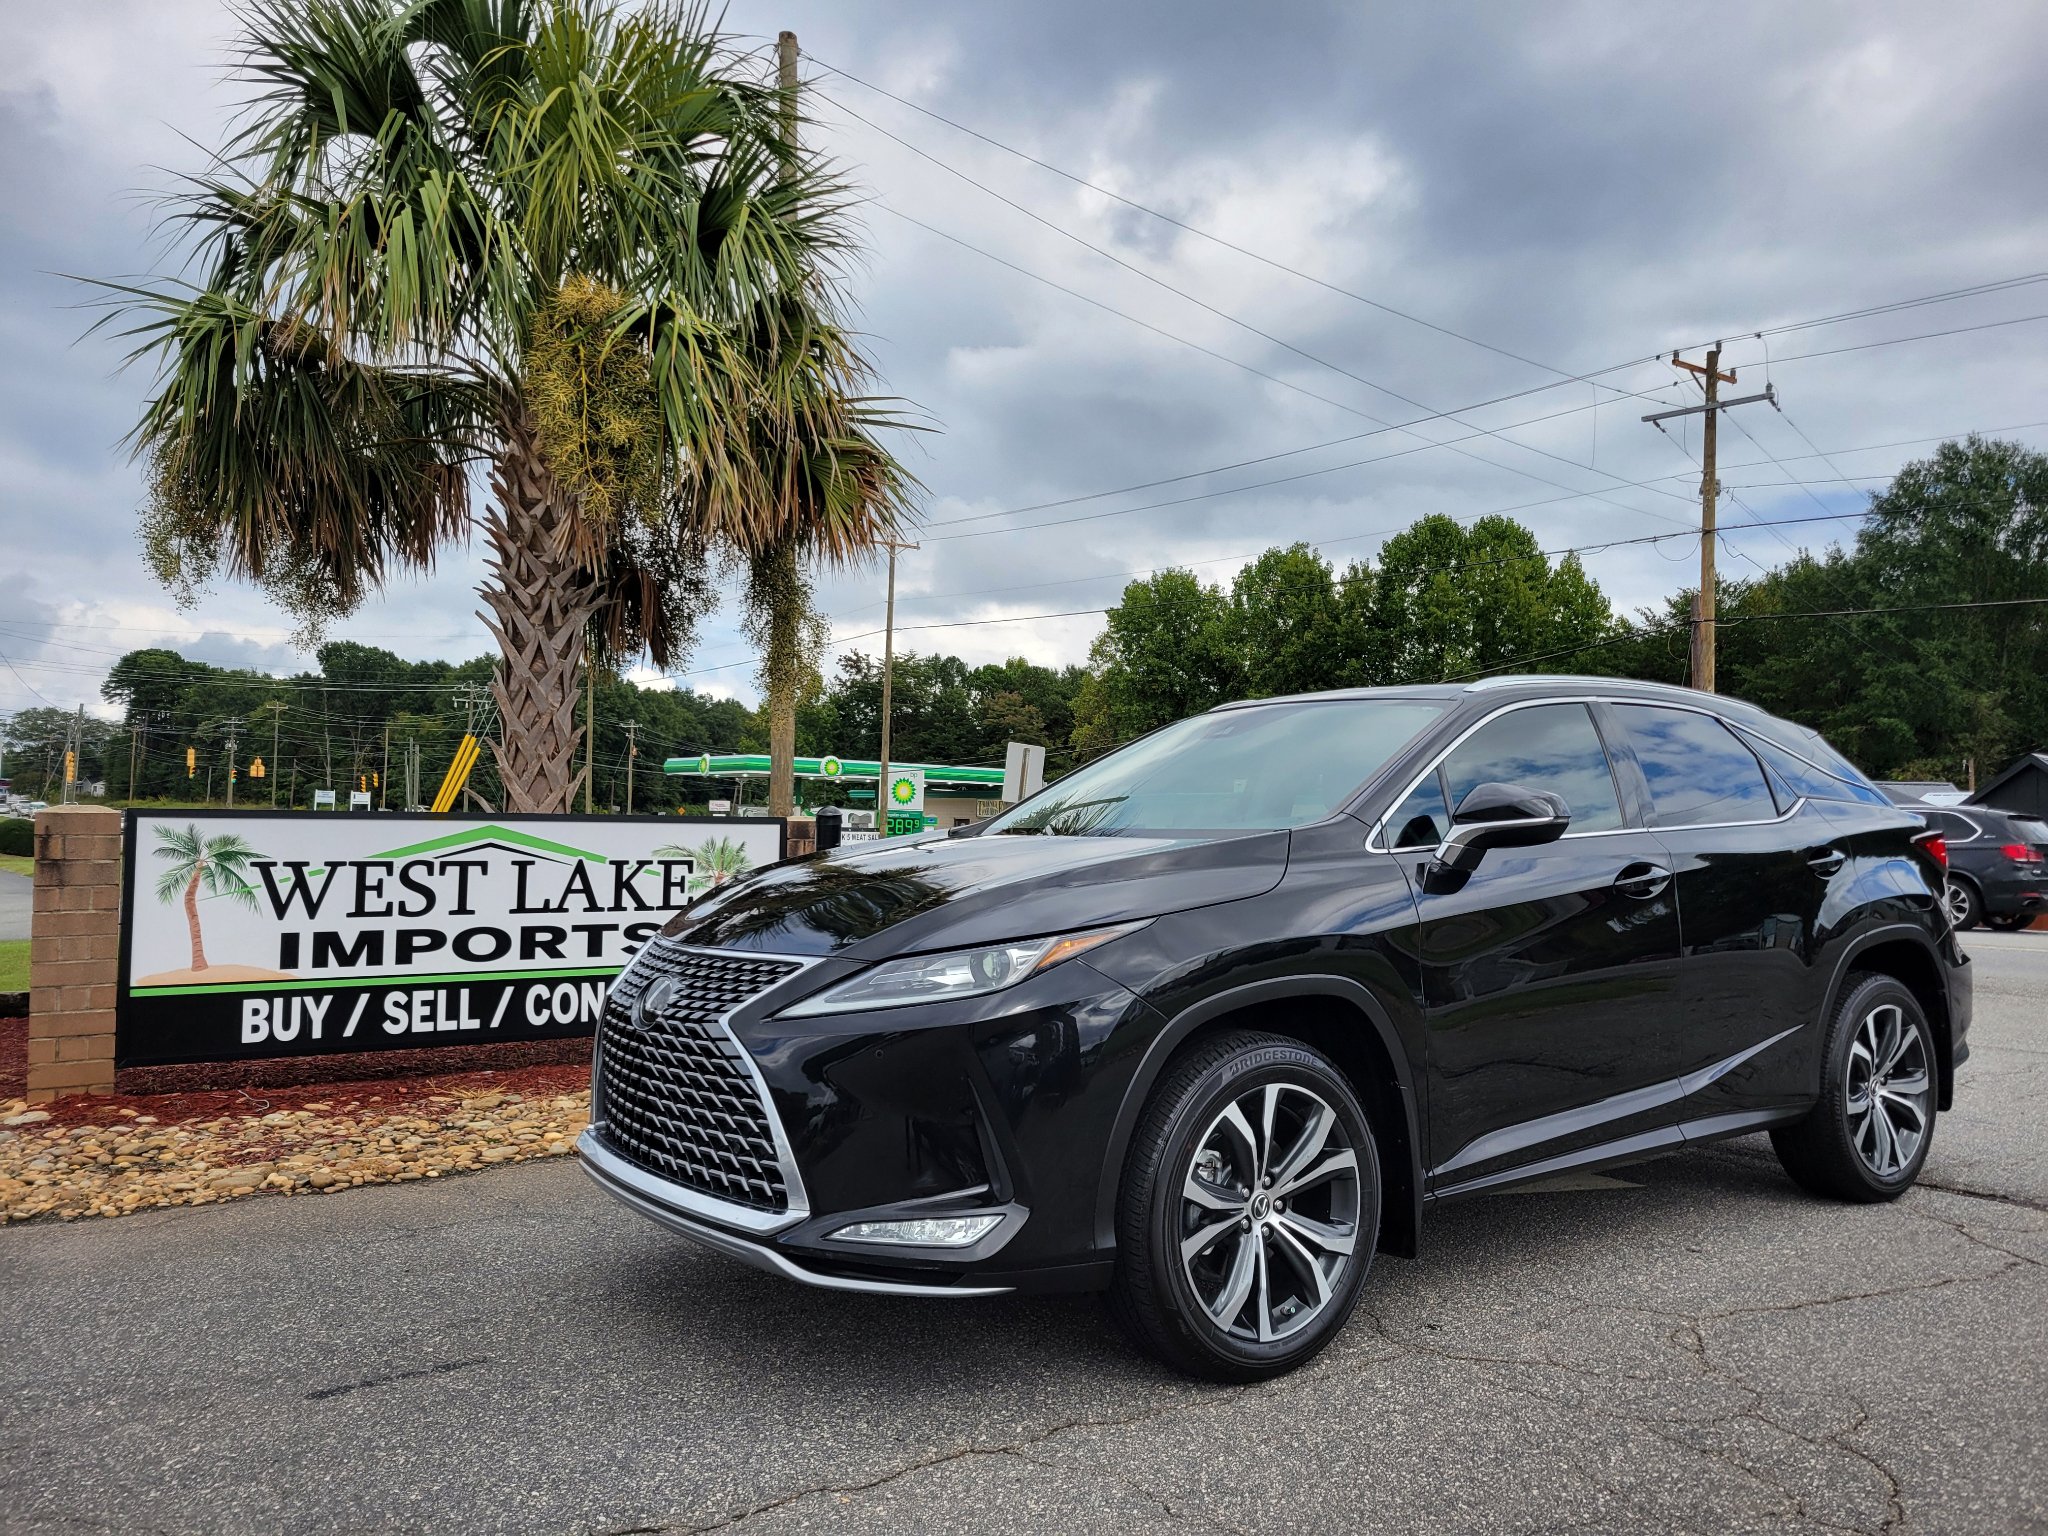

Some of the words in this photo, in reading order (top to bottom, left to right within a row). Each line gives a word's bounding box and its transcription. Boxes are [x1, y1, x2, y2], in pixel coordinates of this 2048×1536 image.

[250, 859, 488, 921] WEST
[508, 858, 695, 915] LAKE
[279, 922, 663, 970] IMPORTS
[241, 994, 334, 1044] BUY
[342, 992, 371, 1038] /
[382, 988, 481, 1036] SELL
[489, 985, 515, 1028] /
[1229, 1049, 1318, 1077] BRIDGESTONE
